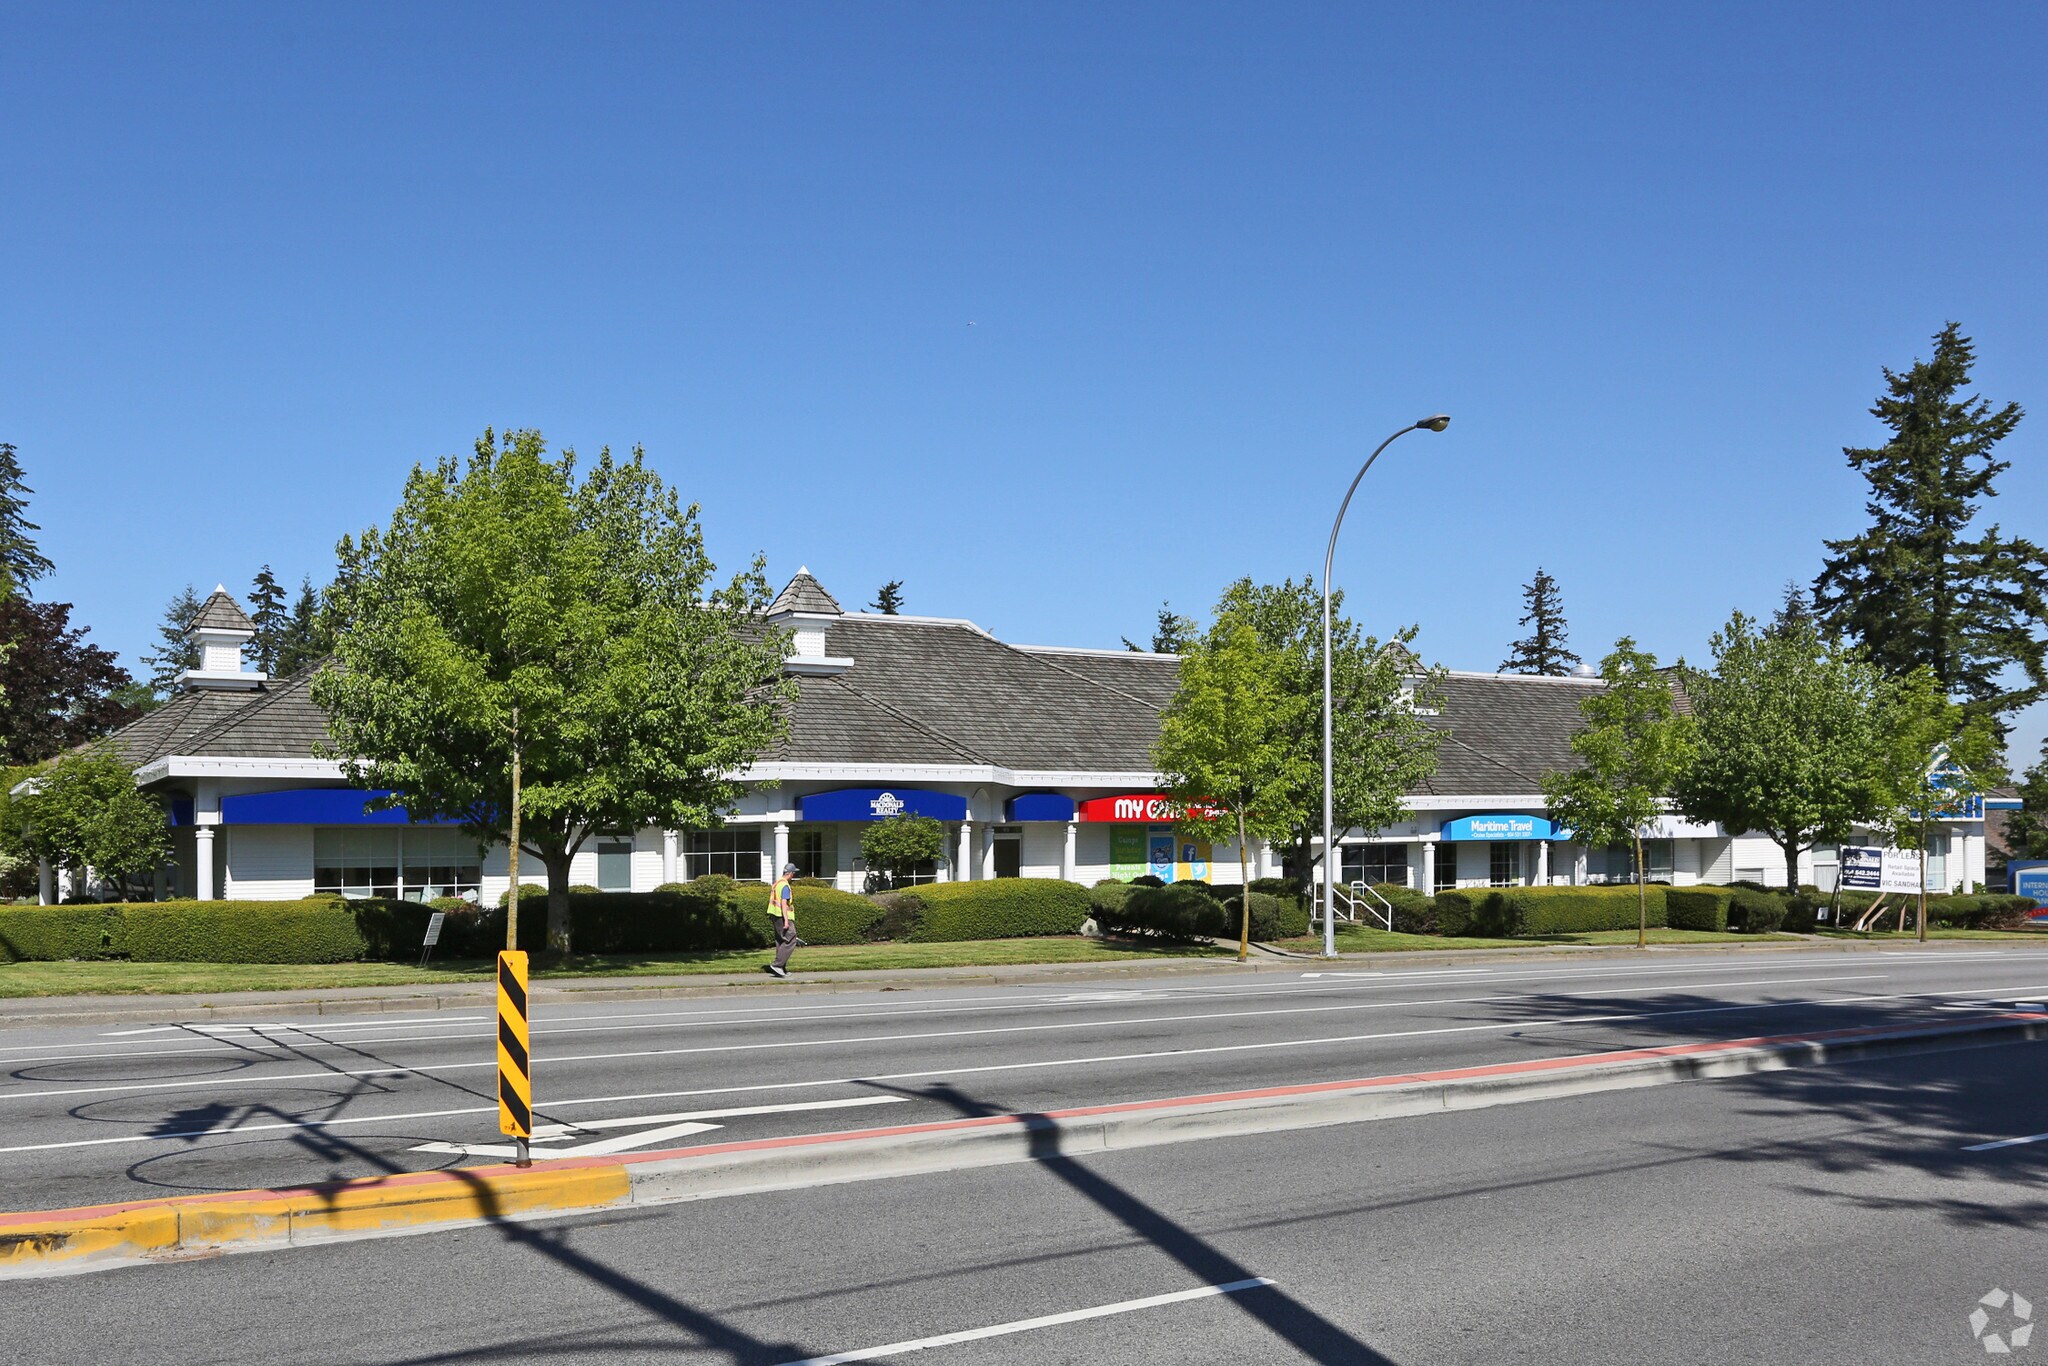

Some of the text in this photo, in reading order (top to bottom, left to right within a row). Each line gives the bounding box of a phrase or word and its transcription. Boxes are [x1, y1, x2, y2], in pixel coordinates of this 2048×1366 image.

[1114, 799, 1144, 819] MY
[1471, 819, 1532, 831] Maritime Travel
[1883, 851, 1920, 860] FOR LEAS
